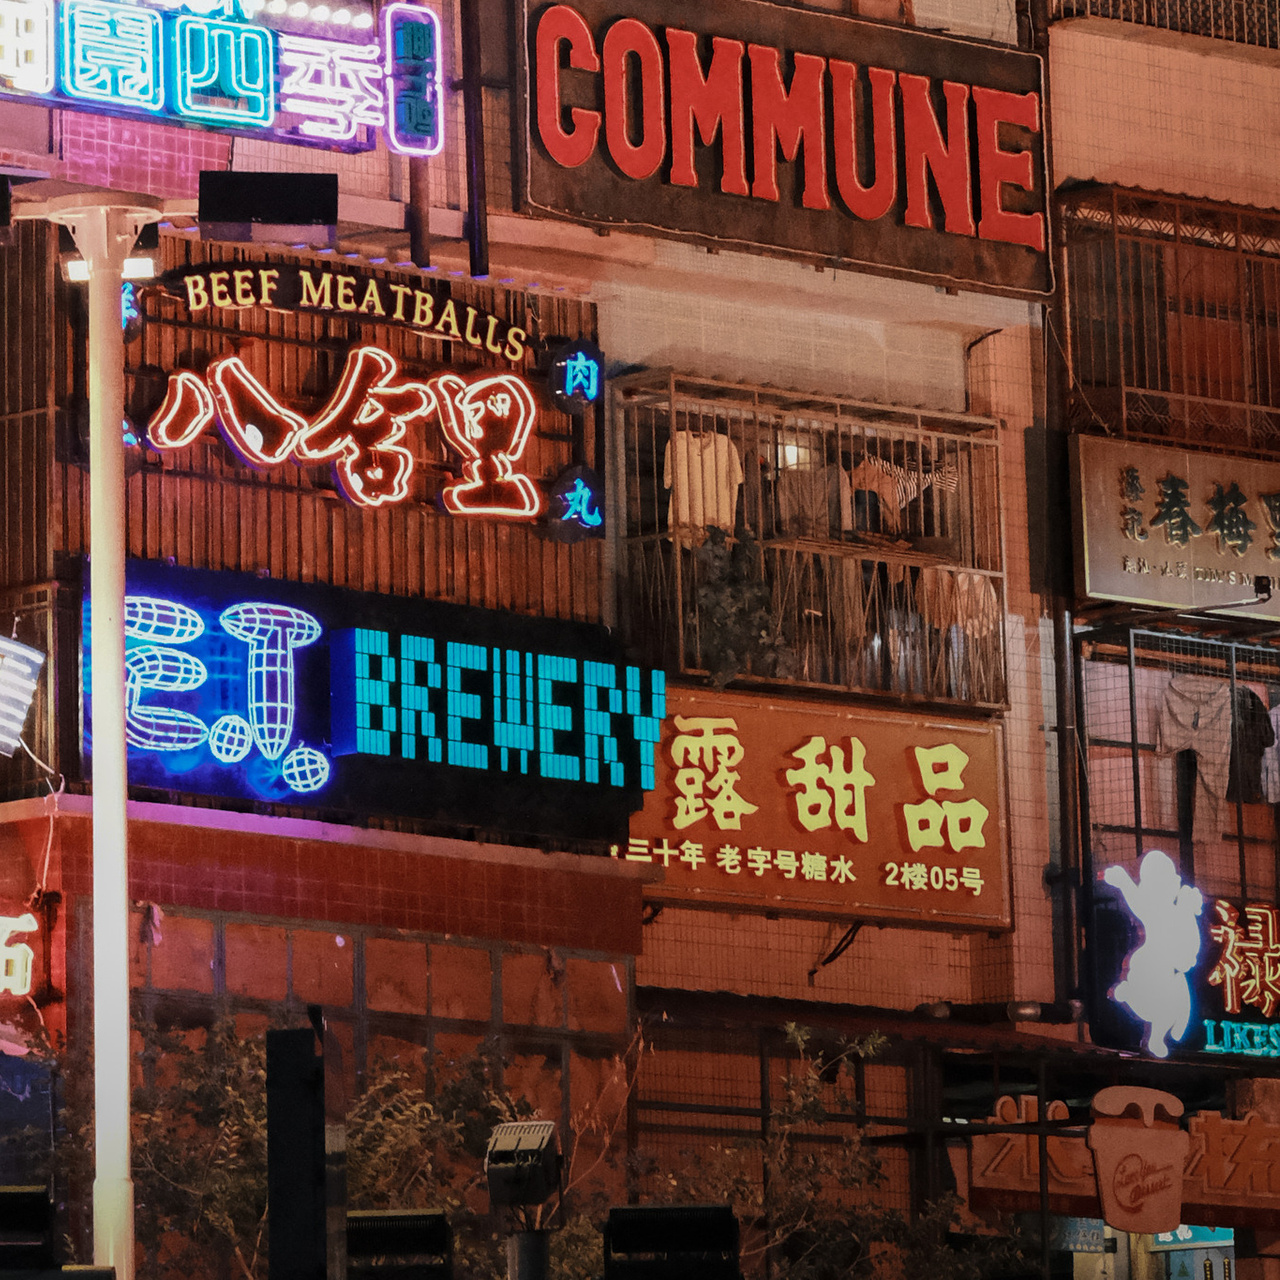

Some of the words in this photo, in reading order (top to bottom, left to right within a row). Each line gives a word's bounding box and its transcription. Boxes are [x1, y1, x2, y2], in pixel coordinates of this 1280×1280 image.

[536, 4, 1045, 252] COMMUNE
[183, 268, 279, 312] BEEF
[299, 269, 527, 362] MEATBALLS
[355, 627, 666, 790] BREWERY
